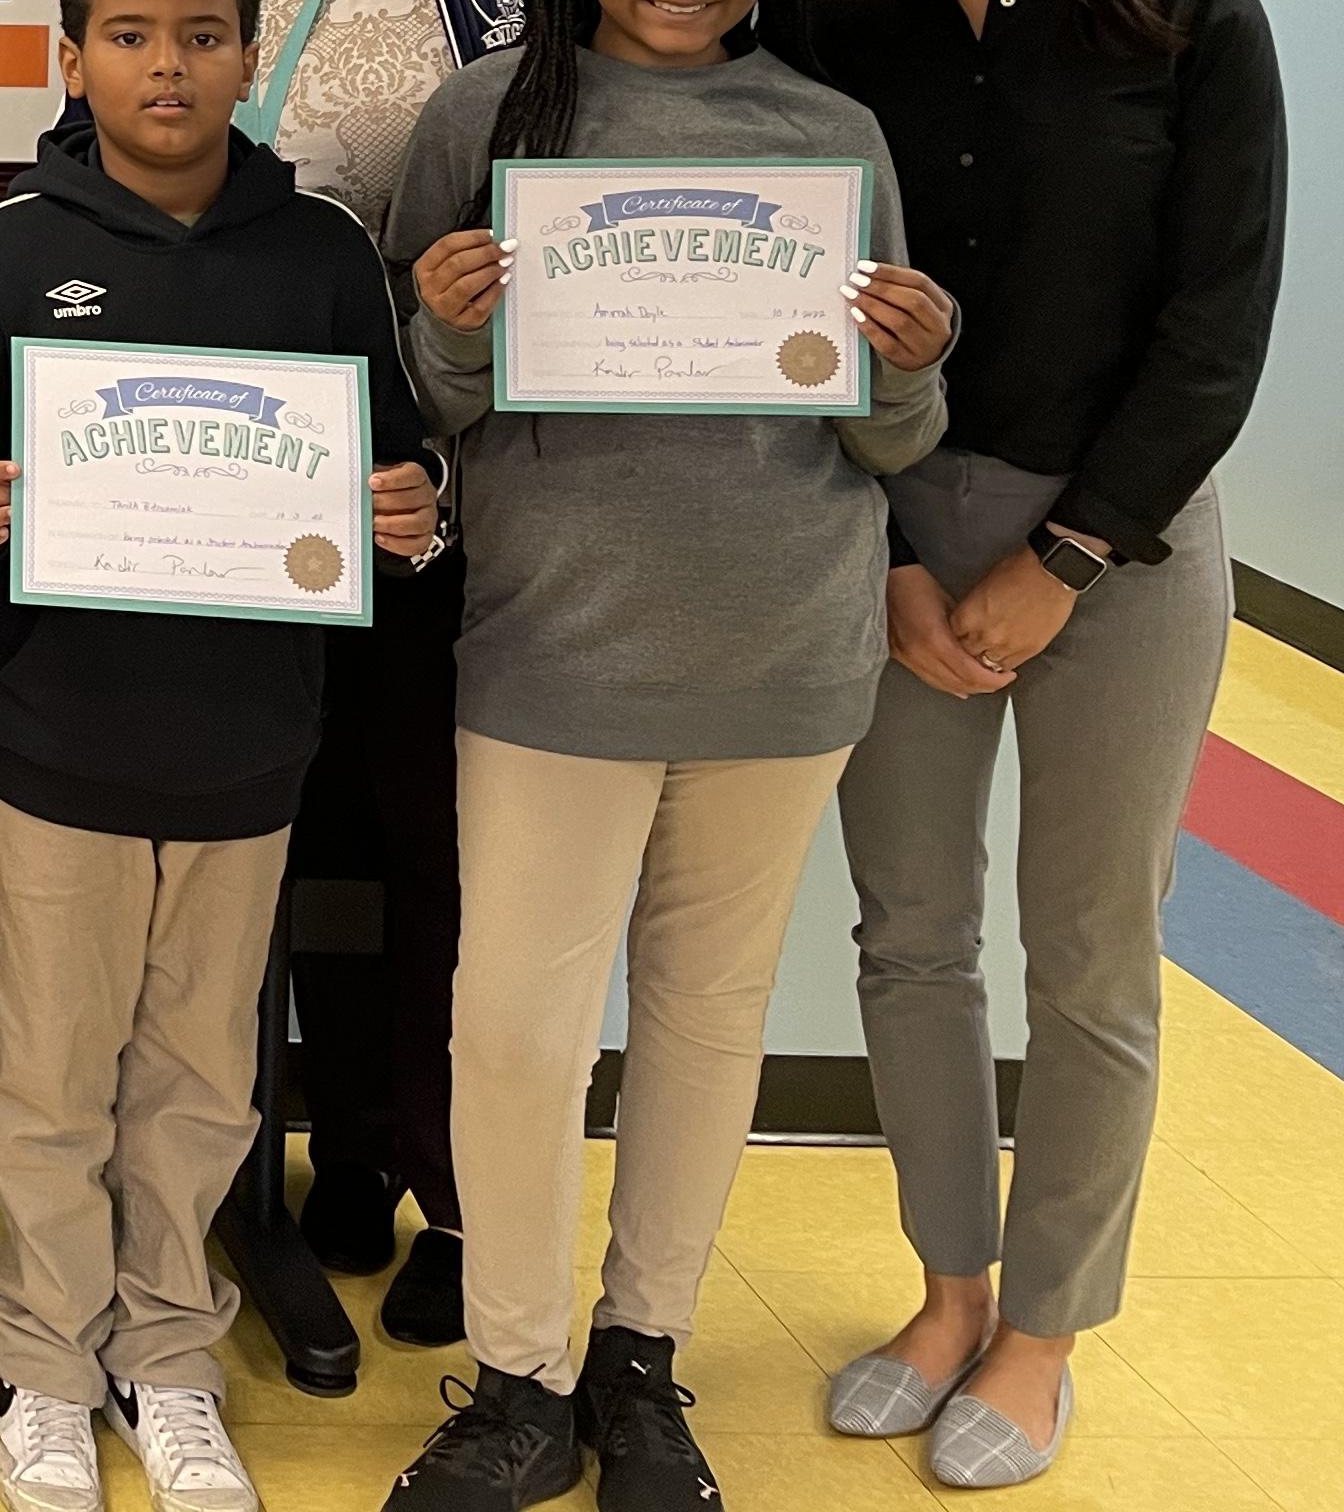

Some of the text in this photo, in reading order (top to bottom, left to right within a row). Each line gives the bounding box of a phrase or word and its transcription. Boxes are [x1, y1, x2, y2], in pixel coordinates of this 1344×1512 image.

[621, 195, 743, 219] Certificate of
[542, 228, 825, 279] ACHIEVEMENT
[53, 304, 102, 319] umbro
[135, 382, 249, 407] Certificate of
[60, 418, 330, 480] ACHIEVEMENT
